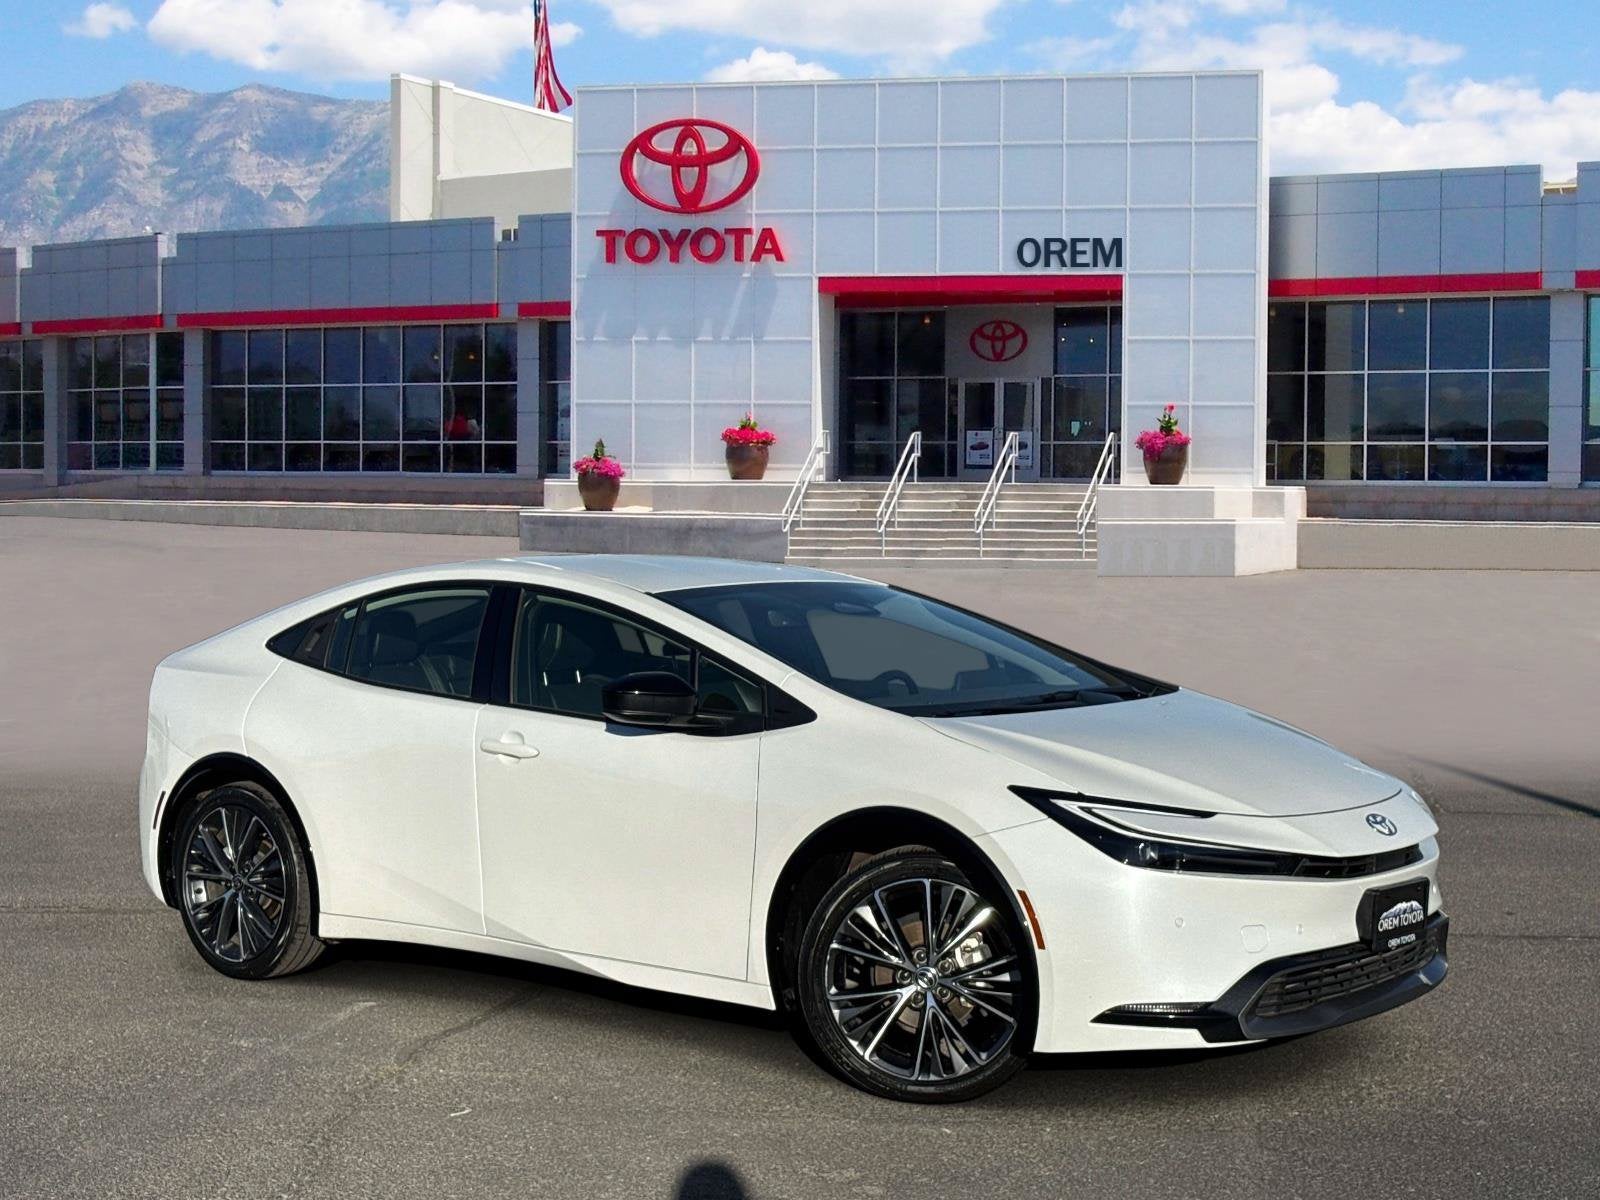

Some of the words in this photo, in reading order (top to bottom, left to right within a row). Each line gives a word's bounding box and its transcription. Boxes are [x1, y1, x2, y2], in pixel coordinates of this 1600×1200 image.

[596, 227, 784, 264] TOYOTA
[1017, 237, 1123, 268] OREM
[1378, 916, 1399, 932] OREM
[1400, 910, 1424, 926] TOYOTA
[1388, 938, 1400, 948] OREM
[1400, 933, 1416, 944] TOYOTA
